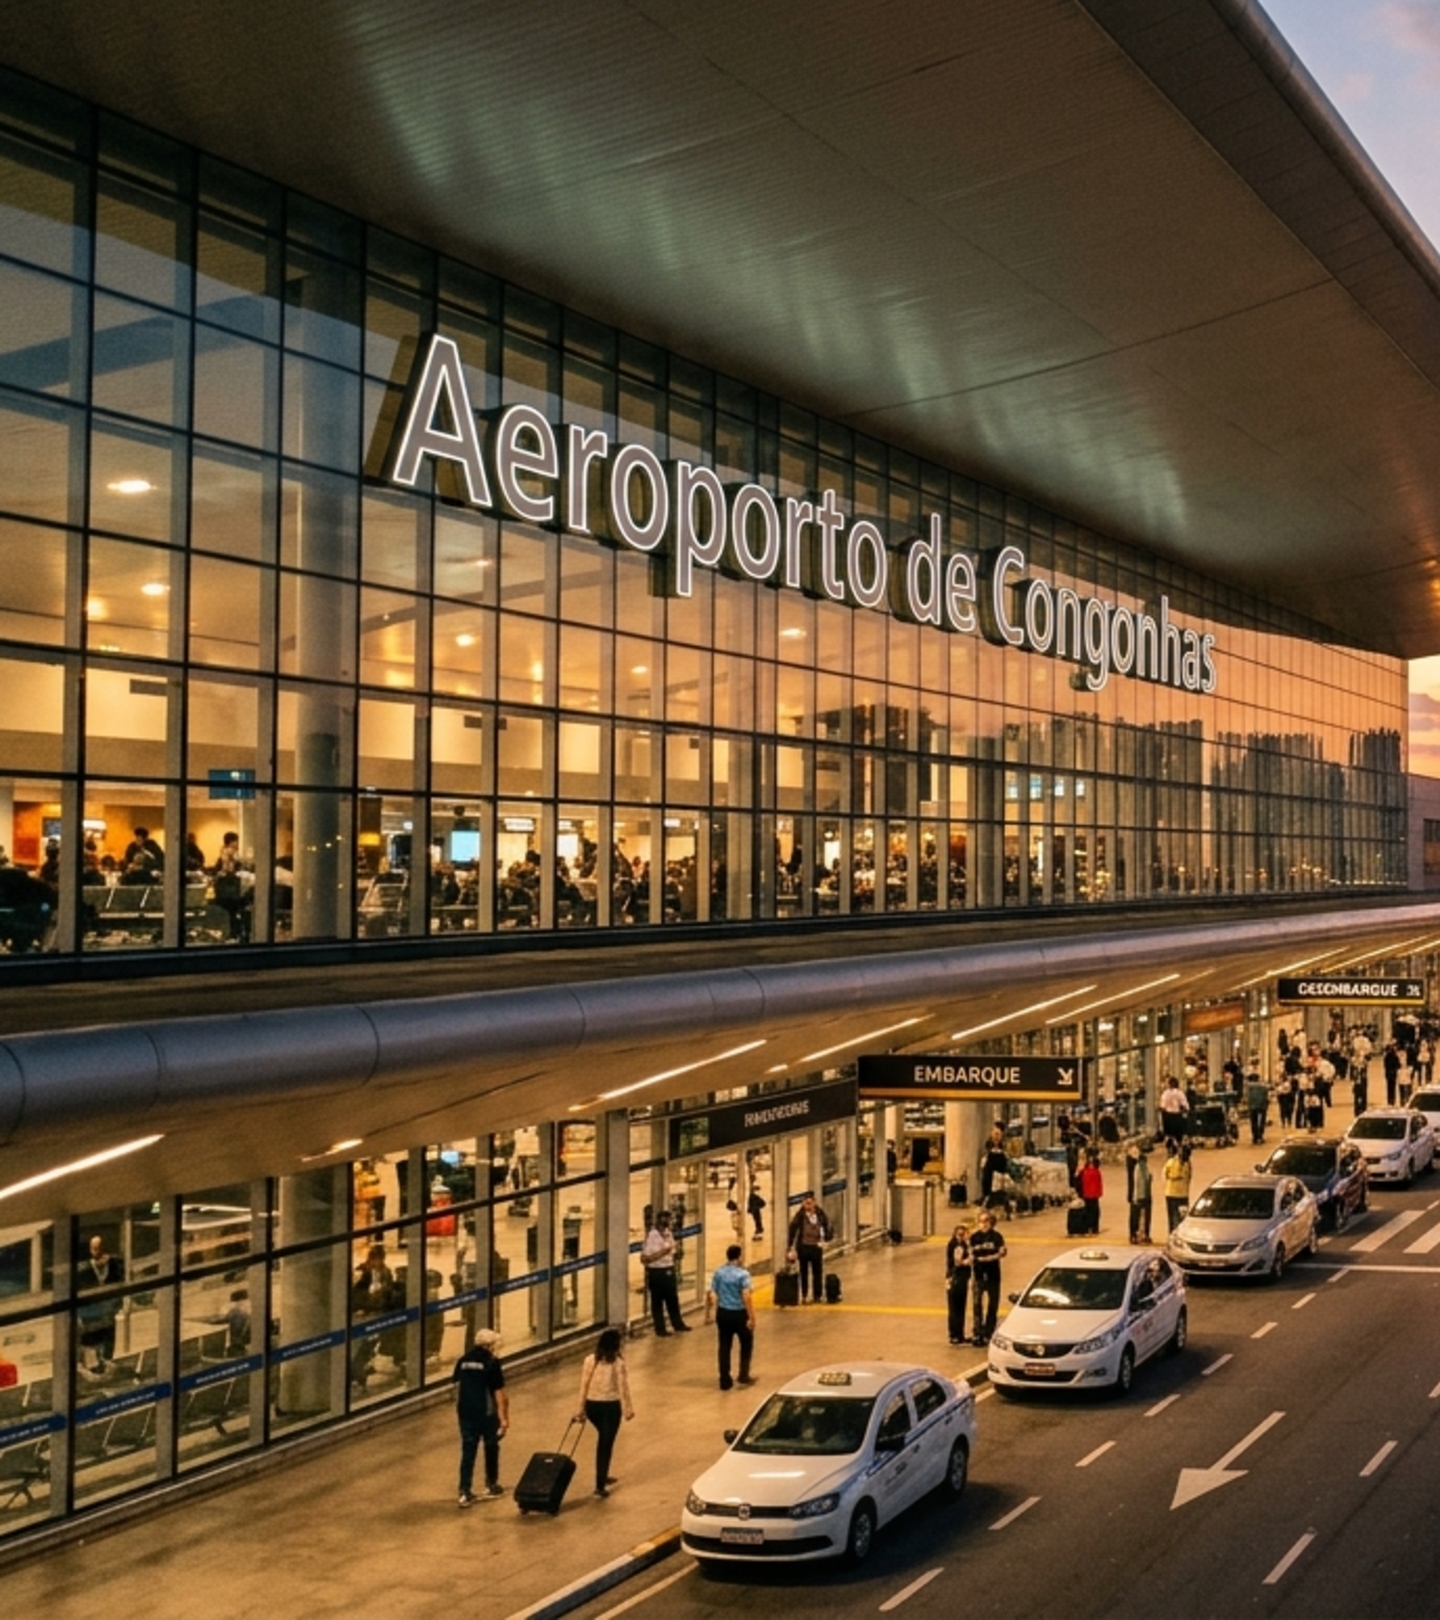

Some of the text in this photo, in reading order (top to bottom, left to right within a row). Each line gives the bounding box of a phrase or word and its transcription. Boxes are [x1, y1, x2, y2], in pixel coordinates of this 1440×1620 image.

[392, 333, 1216, 692] Aeroporto de Congonhas
[914, 1065, 1021, 1087] EMBARQUE
